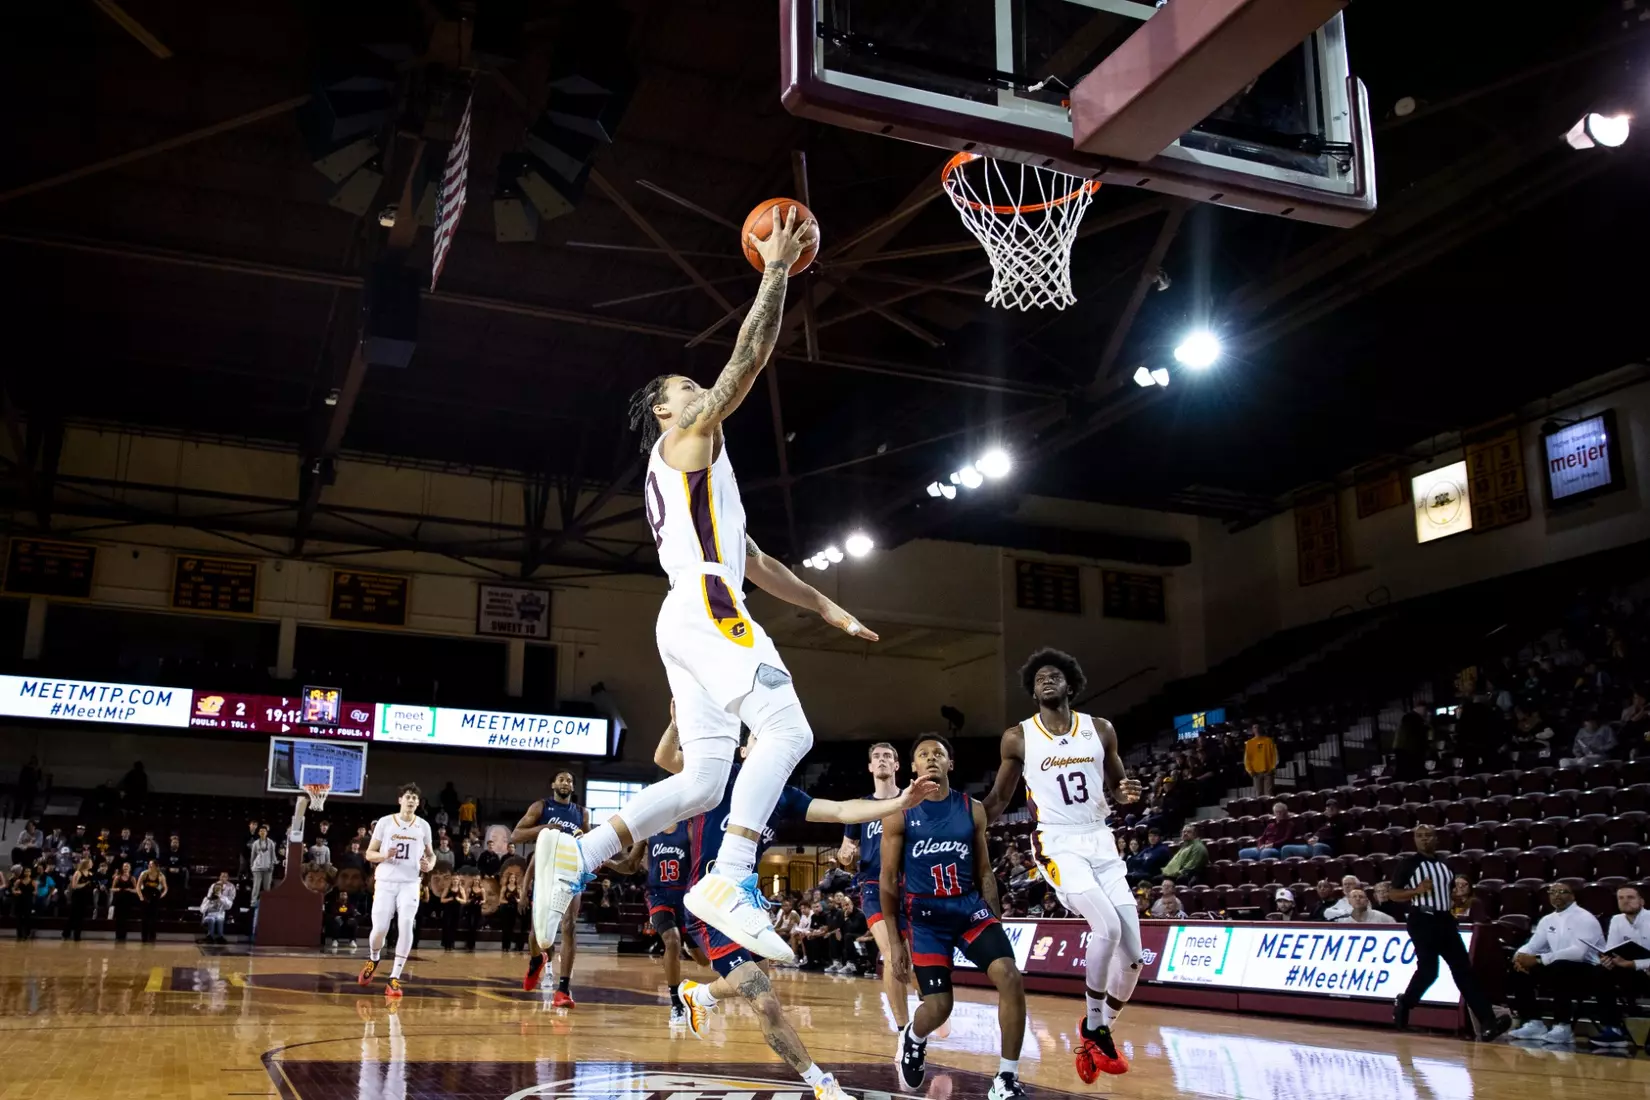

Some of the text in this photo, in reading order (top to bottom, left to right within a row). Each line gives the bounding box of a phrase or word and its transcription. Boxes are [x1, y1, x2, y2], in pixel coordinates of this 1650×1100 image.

[1551, 443, 1606, 473] meijer
[19, 680, 173, 707] MEETMTP.COM
[49, 702, 136, 720] #MeetMtP
[235, 702, 246, 716] 2
[394, 710, 424, 722] meet
[191, 717, 219, 727] FOULS:
[250, 722, 256, 730] 4
[328, 727, 334, 735] 4
[337, 728, 363, 737] FOULS:
[394, 721, 423, 733] here
[461, 713, 590, 736] MEETMTP.COM
[487, 733, 560, 749] #MeetMtP
[1040, 756, 1095, 771] Chippewas
[1056, 771, 1090, 806] 13
[867, 820, 884, 839] Cle
[395, 843, 410, 860] 21
[652, 843, 685, 860] Cleary
[912, 837, 969, 860] Cleary
[659, 859, 680, 882] 13
[930, 862, 962, 897] 11
[1057, 940, 1067, 956] 2
[1184, 934, 1218, 949] meet
[1256, 933, 1416, 965] MEETMTP.CO
[1182, 951, 1212, 967] here
[1284, 964, 1390, 992] #MeetMtP
